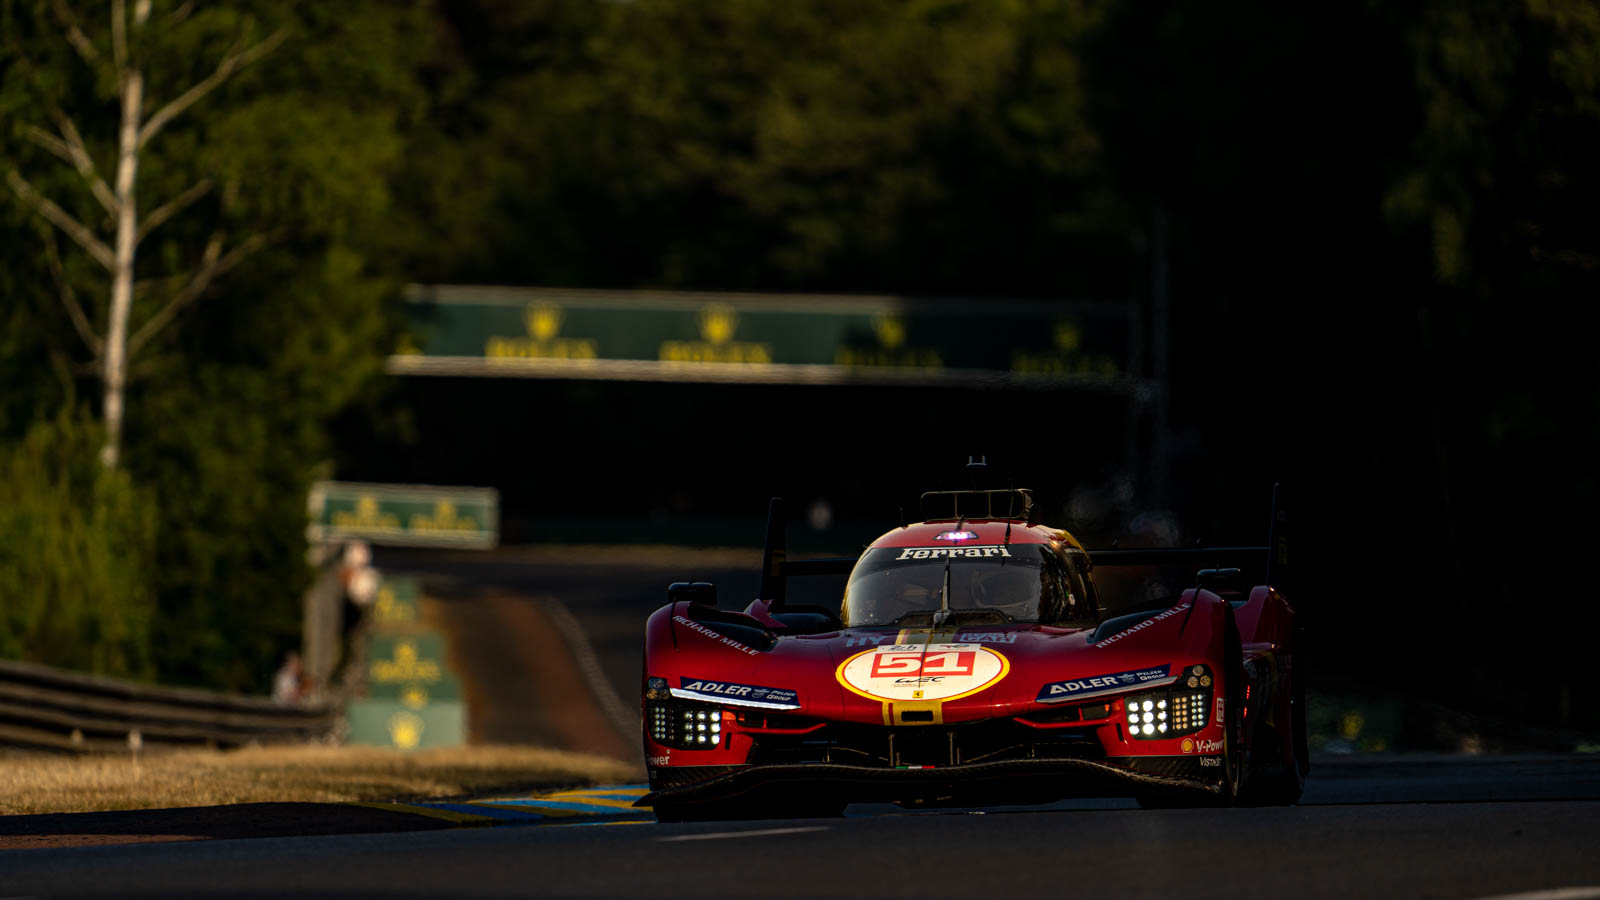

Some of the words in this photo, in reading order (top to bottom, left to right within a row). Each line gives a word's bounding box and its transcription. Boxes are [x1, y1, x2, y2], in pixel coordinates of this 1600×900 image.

[896, 545, 1012, 561] Ferrari
[1096, 620, 1155, 648] RICHARD
[1154, 602, 1192, 621] MILLE
[672, 615, 721, 639] RICHARD
[720, 637, 760, 656] MILLE
[877, 652, 969, 674] 51
[683, 681, 752, 697] ADLER
[1049, 676, 1119, 695] ADLER
